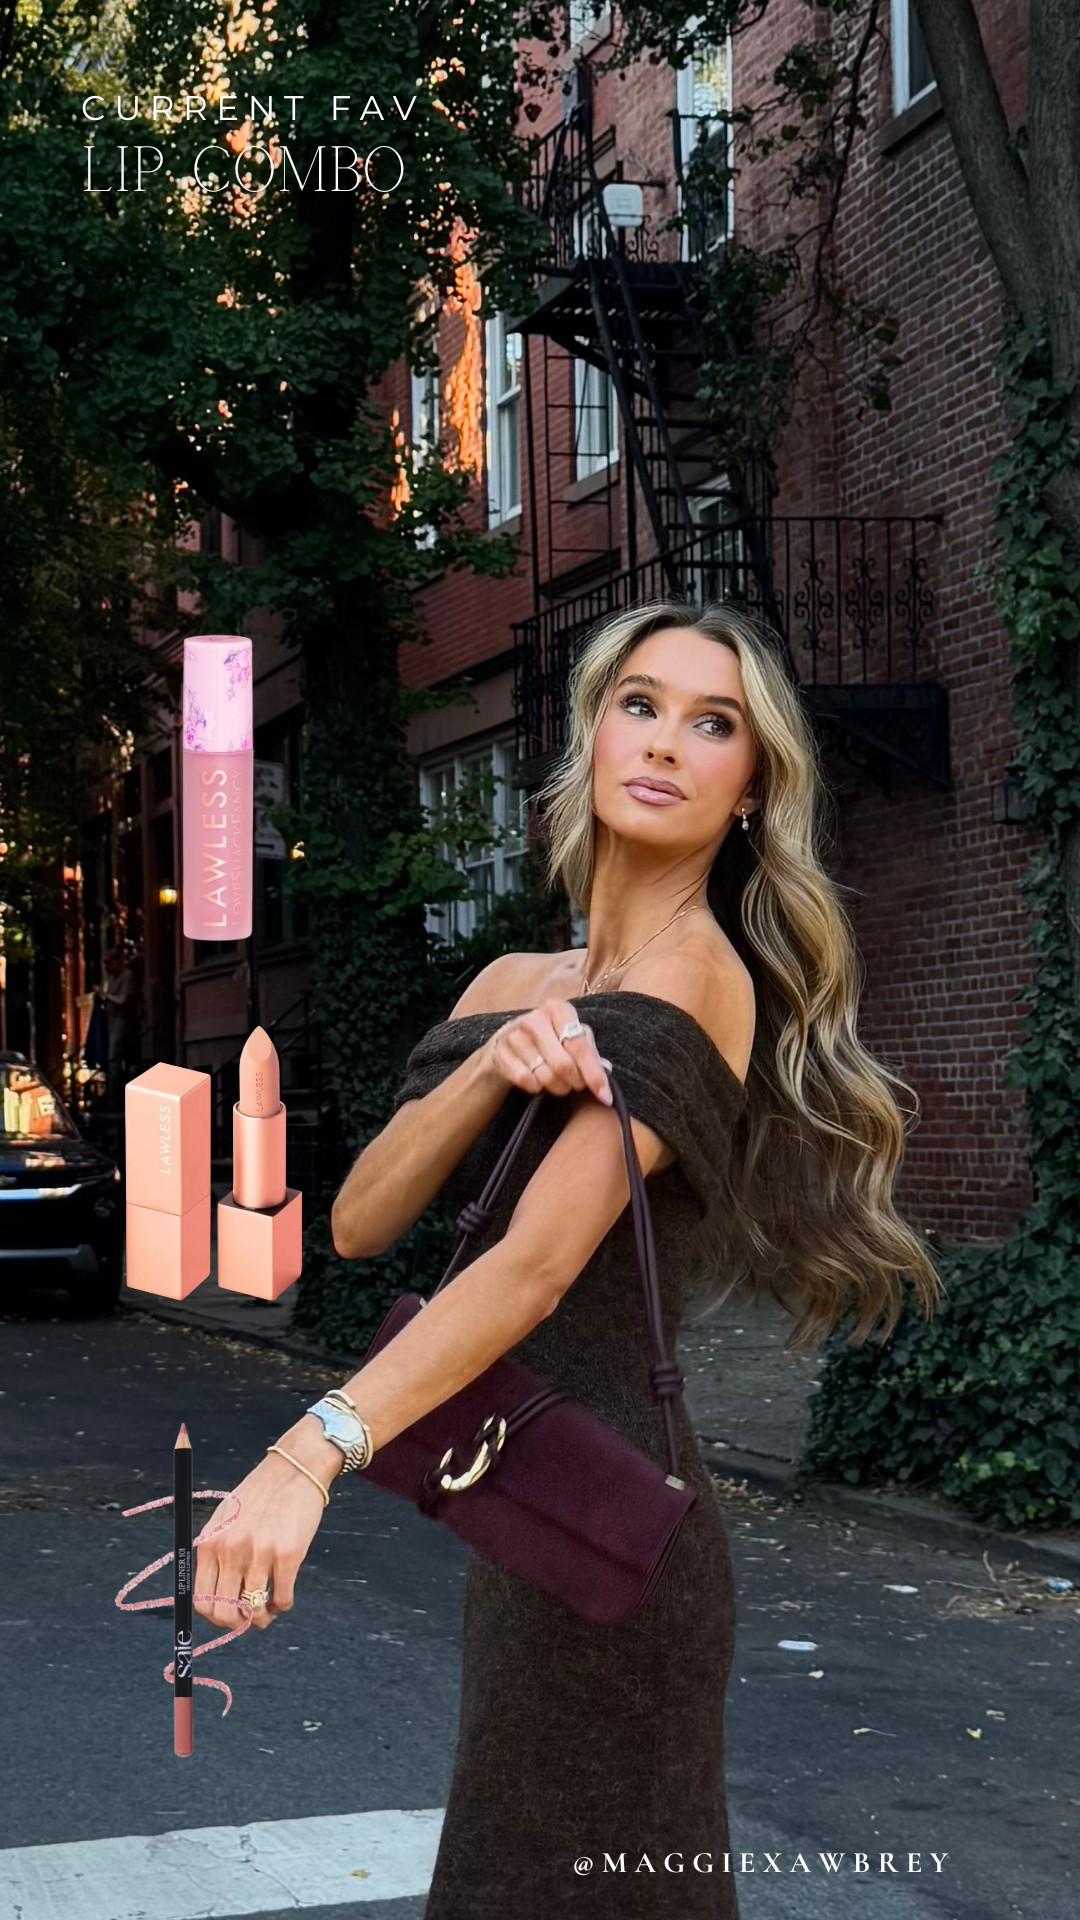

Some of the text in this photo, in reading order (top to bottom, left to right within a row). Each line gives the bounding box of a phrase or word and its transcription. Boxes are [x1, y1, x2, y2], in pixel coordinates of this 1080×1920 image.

[202, 769, 228, 927] LAWLESS
[255, 1071, 264, 1112] LAWLESS
[160, 1104, 171, 1175] LAWLESS
[178, 1558, 186, 1582] LINER
[178, 1582, 186, 1595] LIP
[174, 1630, 192, 1678] saie
